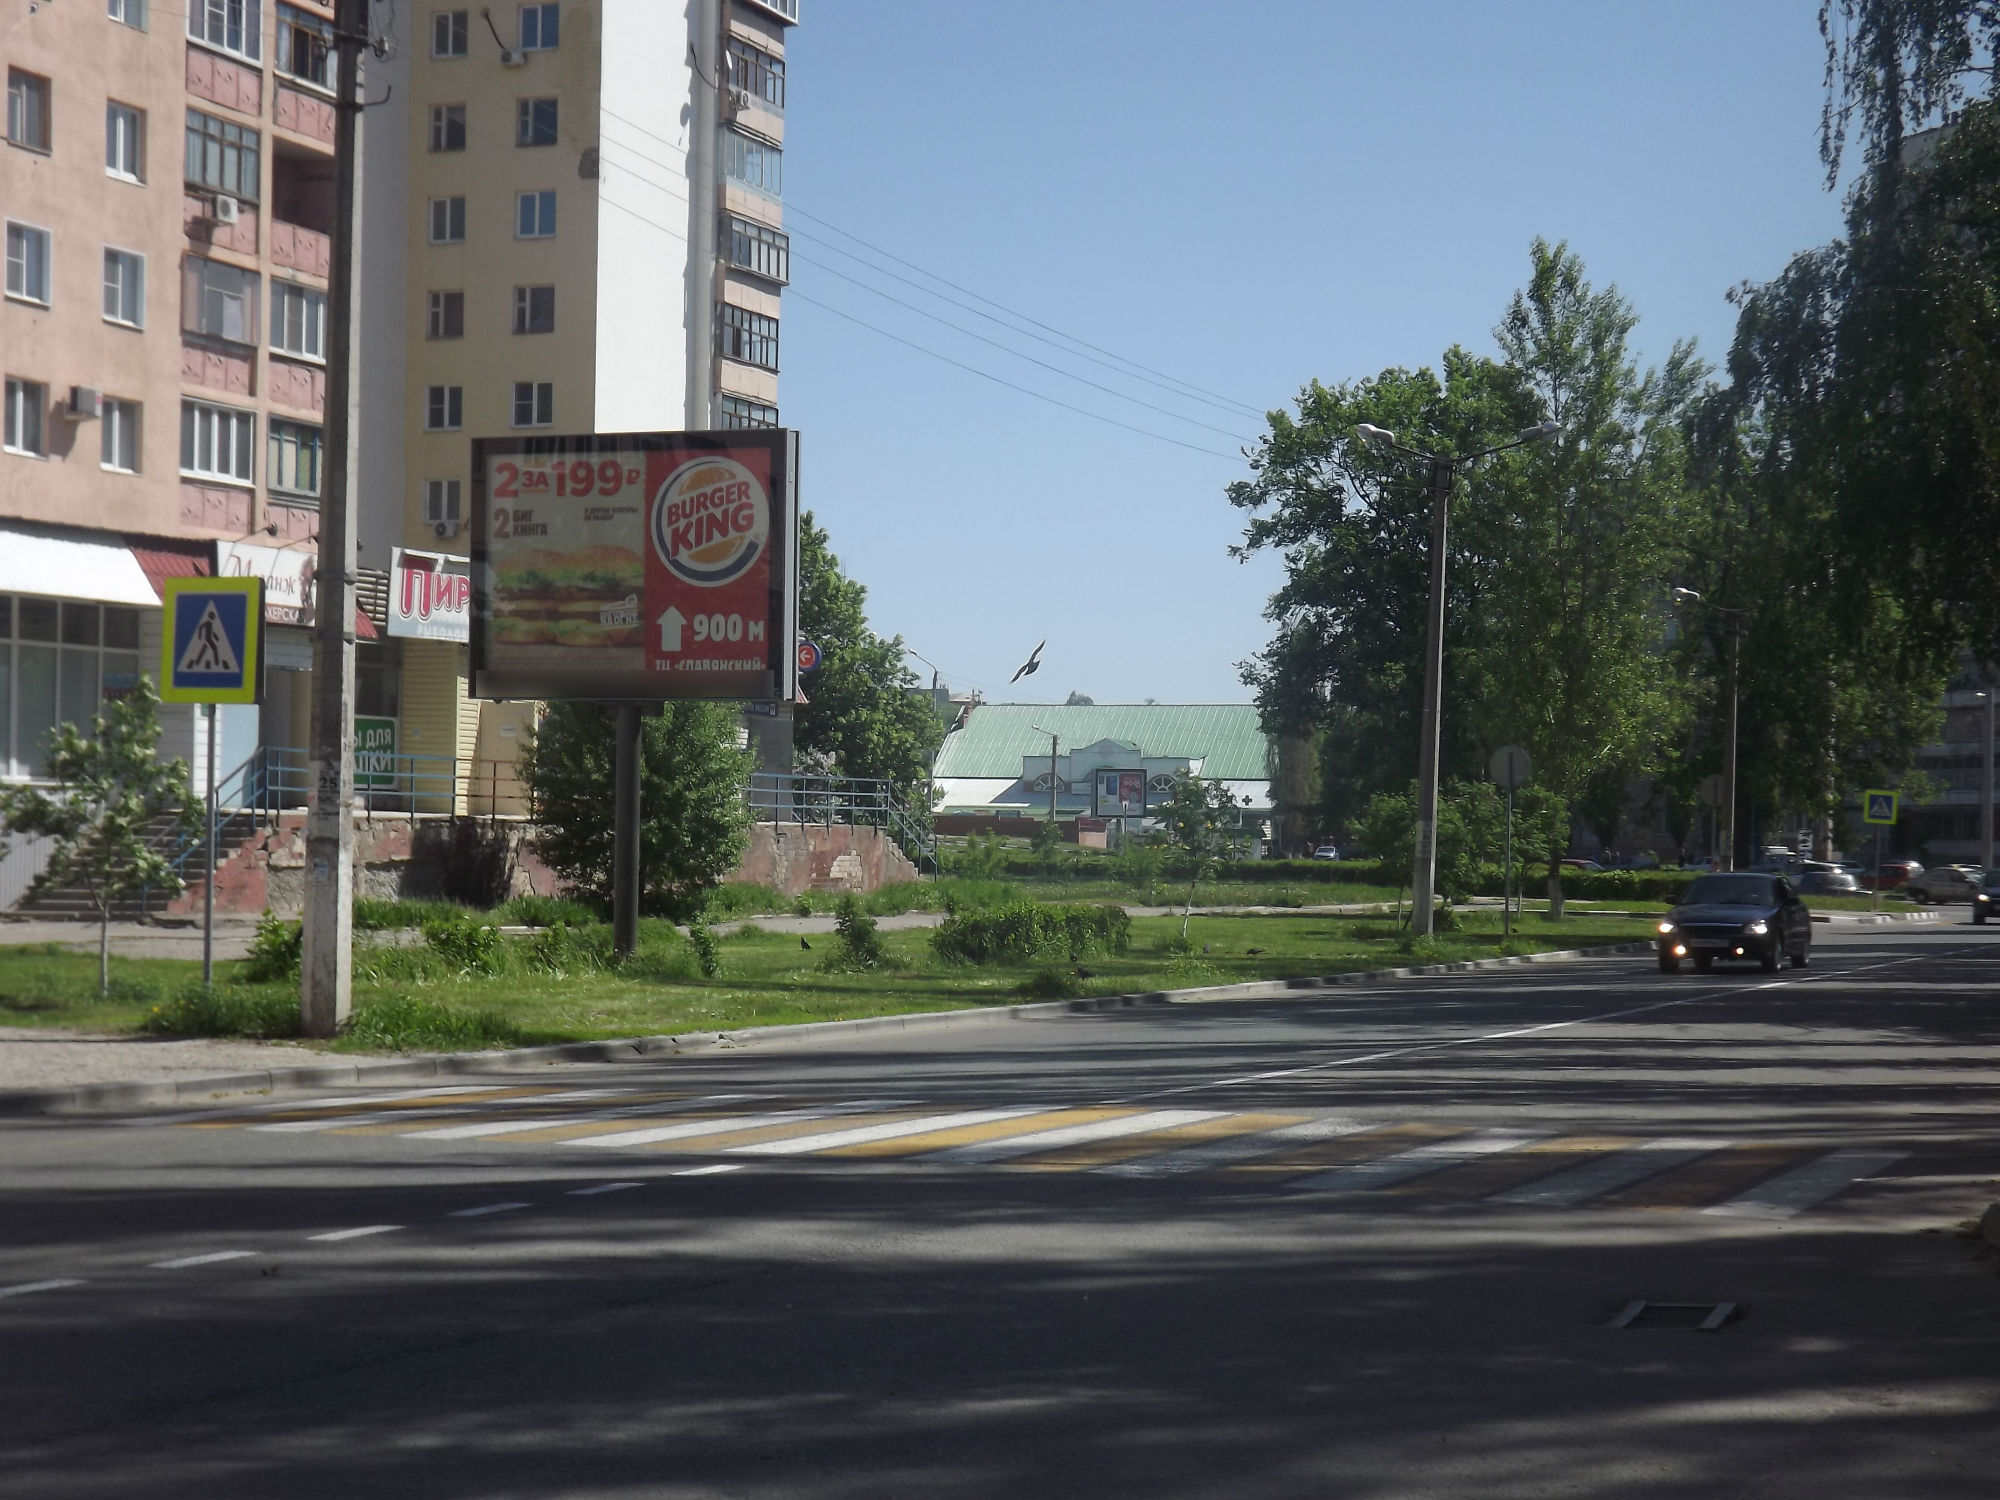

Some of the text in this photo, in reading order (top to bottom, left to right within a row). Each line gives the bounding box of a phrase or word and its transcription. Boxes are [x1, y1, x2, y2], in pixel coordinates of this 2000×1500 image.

[493, 462, 519, 498] 2
[513, 509, 534, 522] БИГ
[667, 481, 751, 528] BURGER
[494, 508, 510, 538] 2
[670, 502, 754, 560] KING
[400, 555, 470, 619] Пир
[693, 613, 743, 642] 900
[366, 728, 392, 749] ДЛЯ
